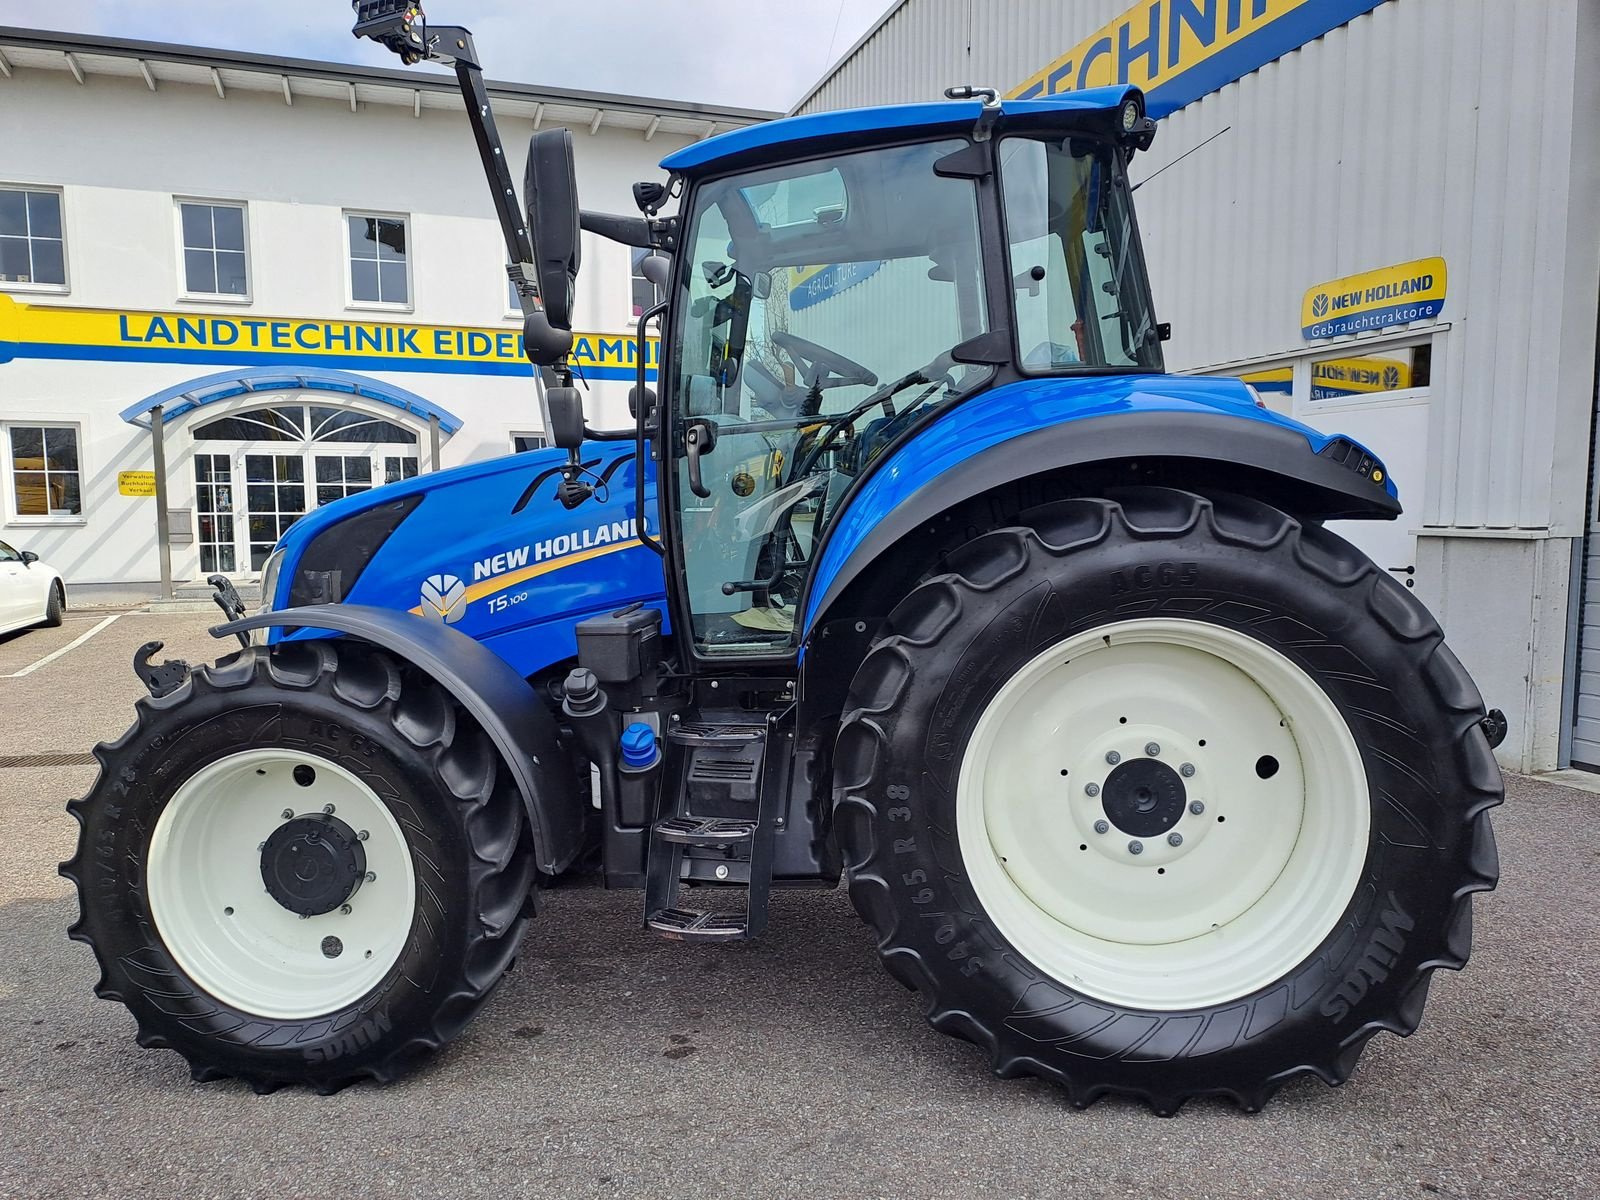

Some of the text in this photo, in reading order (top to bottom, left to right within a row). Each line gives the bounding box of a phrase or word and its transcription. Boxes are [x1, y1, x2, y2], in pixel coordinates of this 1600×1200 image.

[807, 262, 857, 299] AGRICULTURE
[1331, 274, 1434, 311] NEW HOLLAND
[118, 314, 422, 354] LANDTECHNIK
[1311, 305, 1433, 337] Gebrauchttraktore
[473, 518, 648, 581] NEW HOLLAND
[886, 784, 985, 977] 540/65 R 38
[1319, 889, 1416, 1025] Mitas
